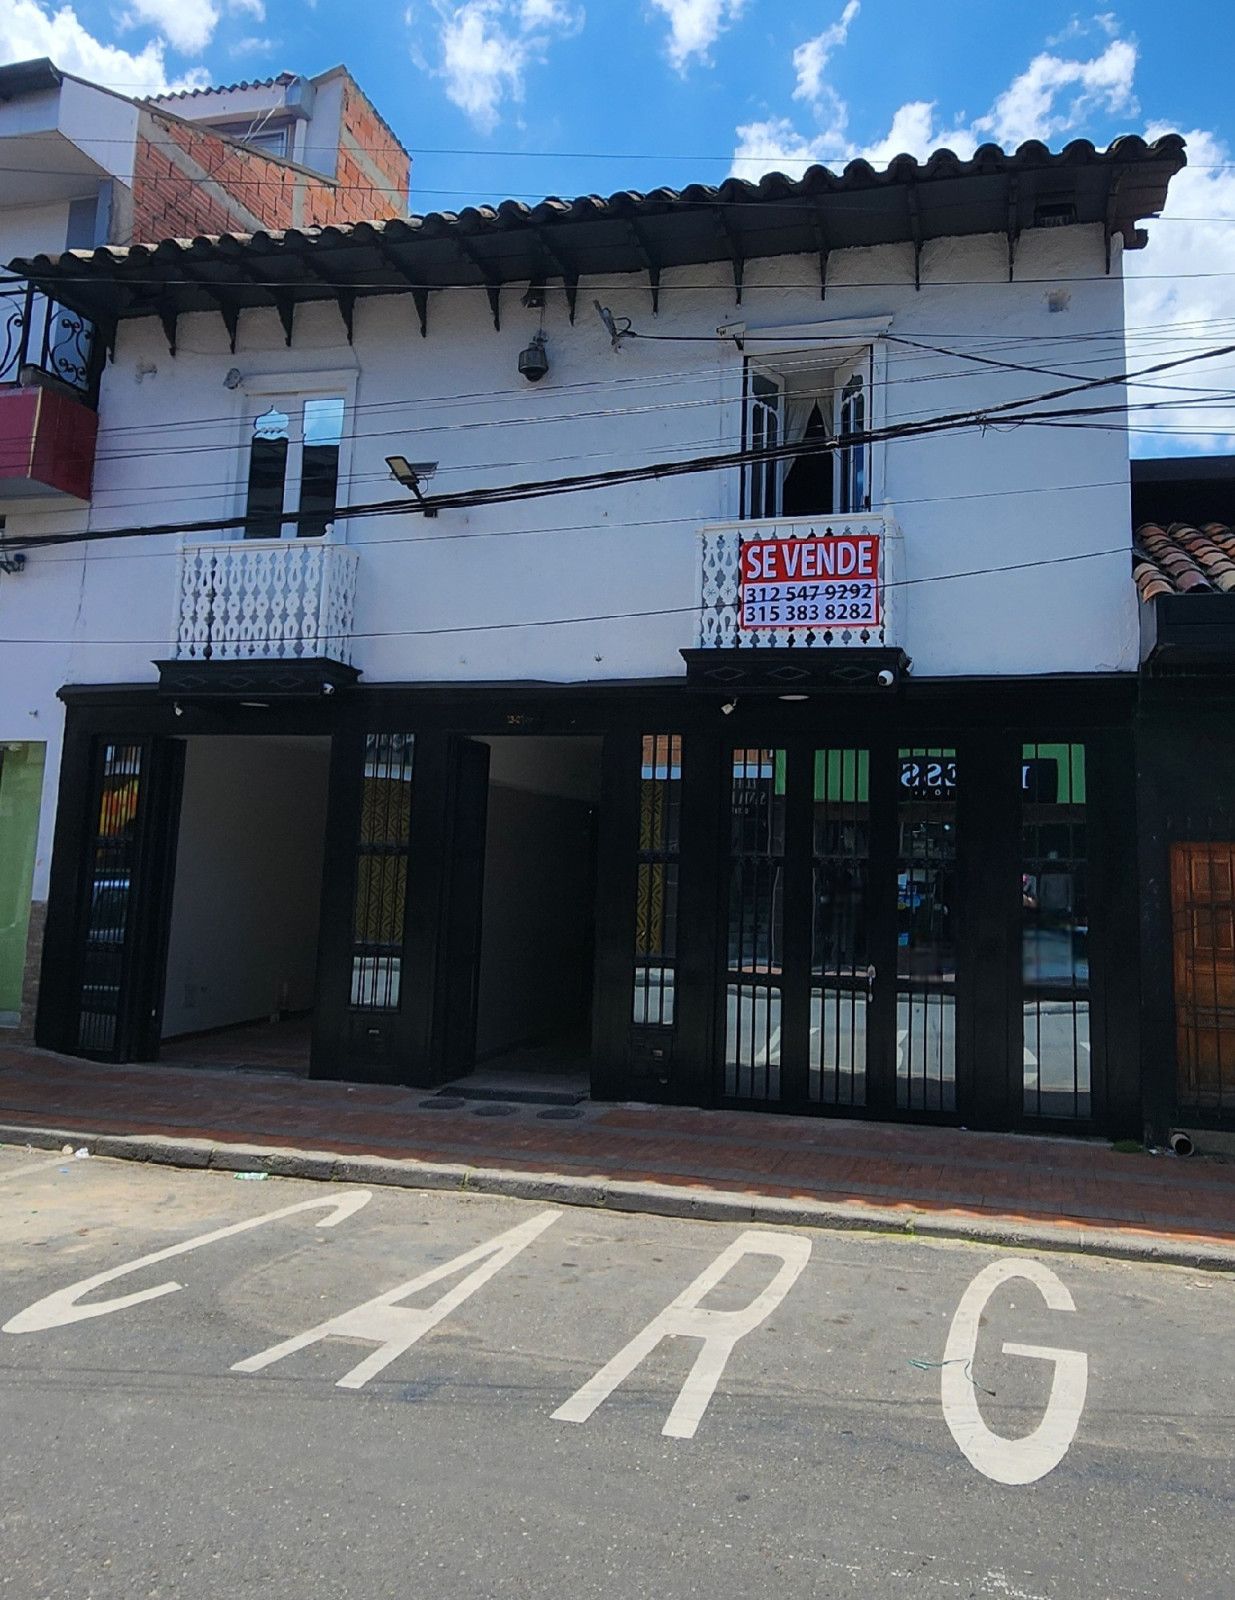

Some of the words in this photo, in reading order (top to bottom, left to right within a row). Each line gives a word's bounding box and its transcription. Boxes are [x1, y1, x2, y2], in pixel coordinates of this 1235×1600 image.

[746, 545, 777, 579] SE
[782, 541, 873, 577] VENDE
[746, 587, 780, 604] 312
[786, 585, 820, 601] 547
[825, 584, 872, 600] 9292
[746, 606, 780, 622] 315
[786, 605, 819, 621] 383
[825, 603, 872, 620] 8282
